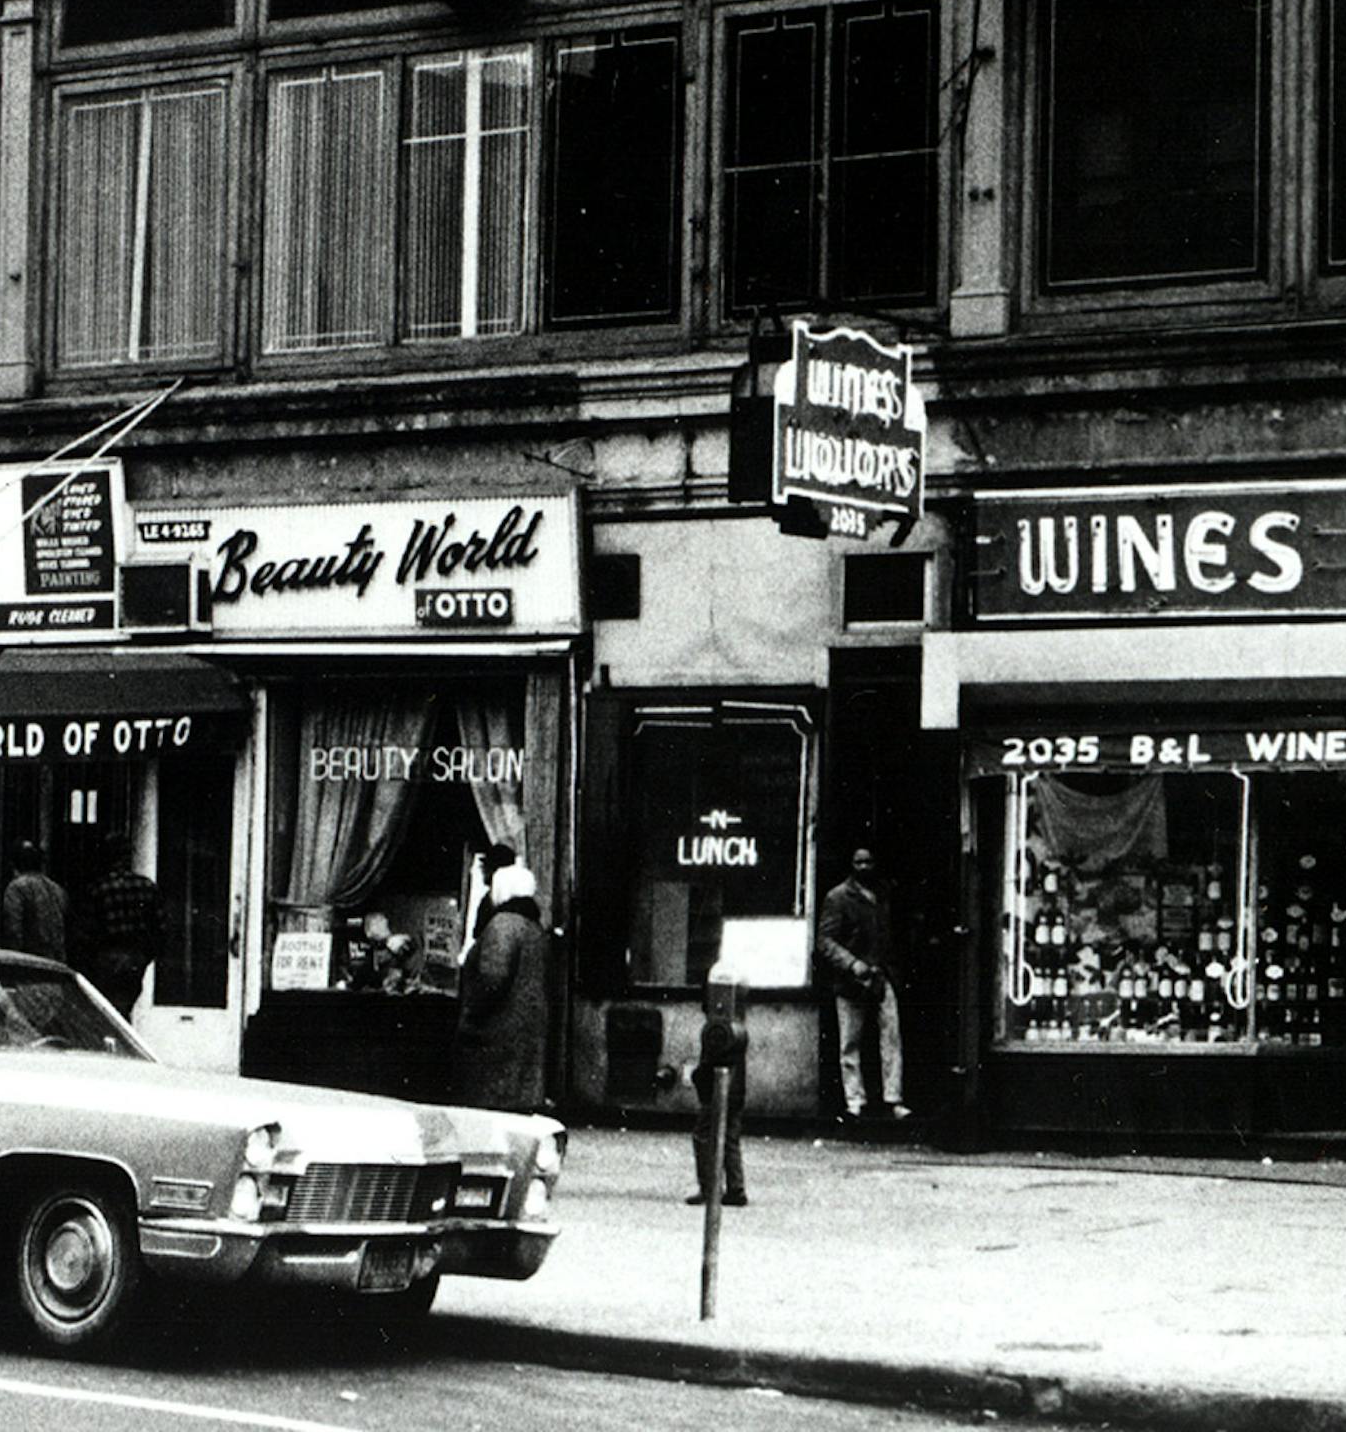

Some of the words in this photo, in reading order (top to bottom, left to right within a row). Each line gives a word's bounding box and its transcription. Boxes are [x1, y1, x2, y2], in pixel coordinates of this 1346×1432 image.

[784, 425, 921, 498] LIQUORS
[212, 523, 385, 604] Beauty
[396, 506, 545, 587] World
[1015, 508, 1305, 597] WINES
[434, 591, 510, 620] OTTO
[63, 722, 102, 757] OF
[112, 716, 192, 755] OTTO
[1002, 736, 1101, 764] 2035
[1129, 733, 1212, 763] B&L
[309, 747, 419, 781] BEAUTY
[432, 747, 525, 782] SALON
[677, 836, 758, 866] LUNCH
